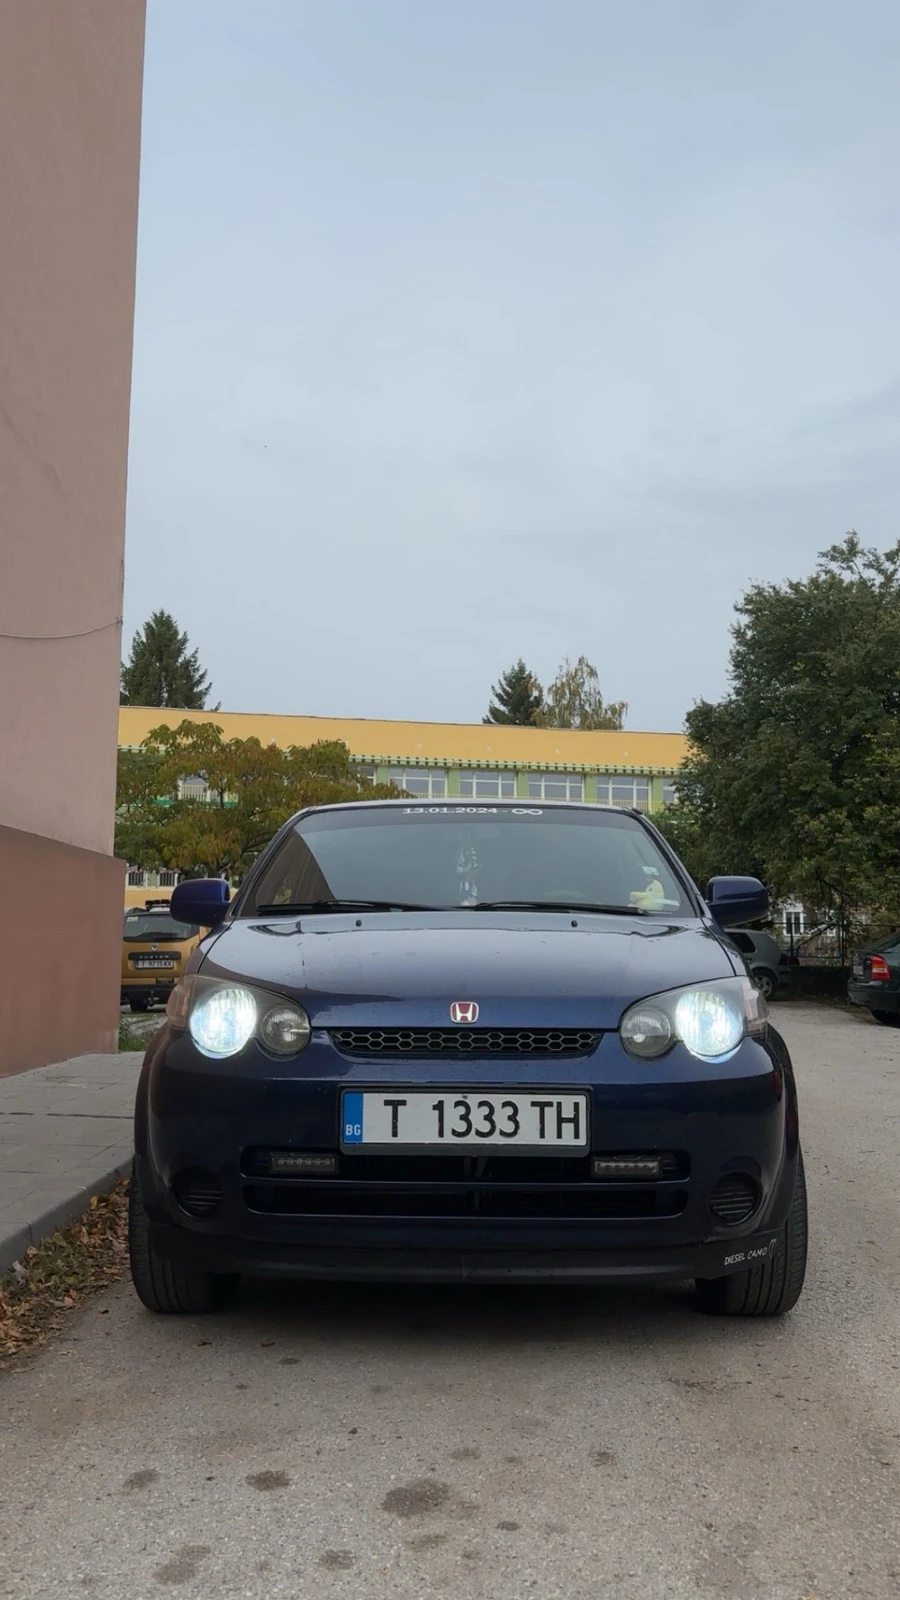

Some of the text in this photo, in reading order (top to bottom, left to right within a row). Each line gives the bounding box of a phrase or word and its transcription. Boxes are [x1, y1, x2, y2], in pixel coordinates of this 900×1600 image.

[383, 1099, 580, 1139] T 1333 TH
[345, 1124, 361, 1136] BG
[724, 1252, 746, 1266] DIESEL
